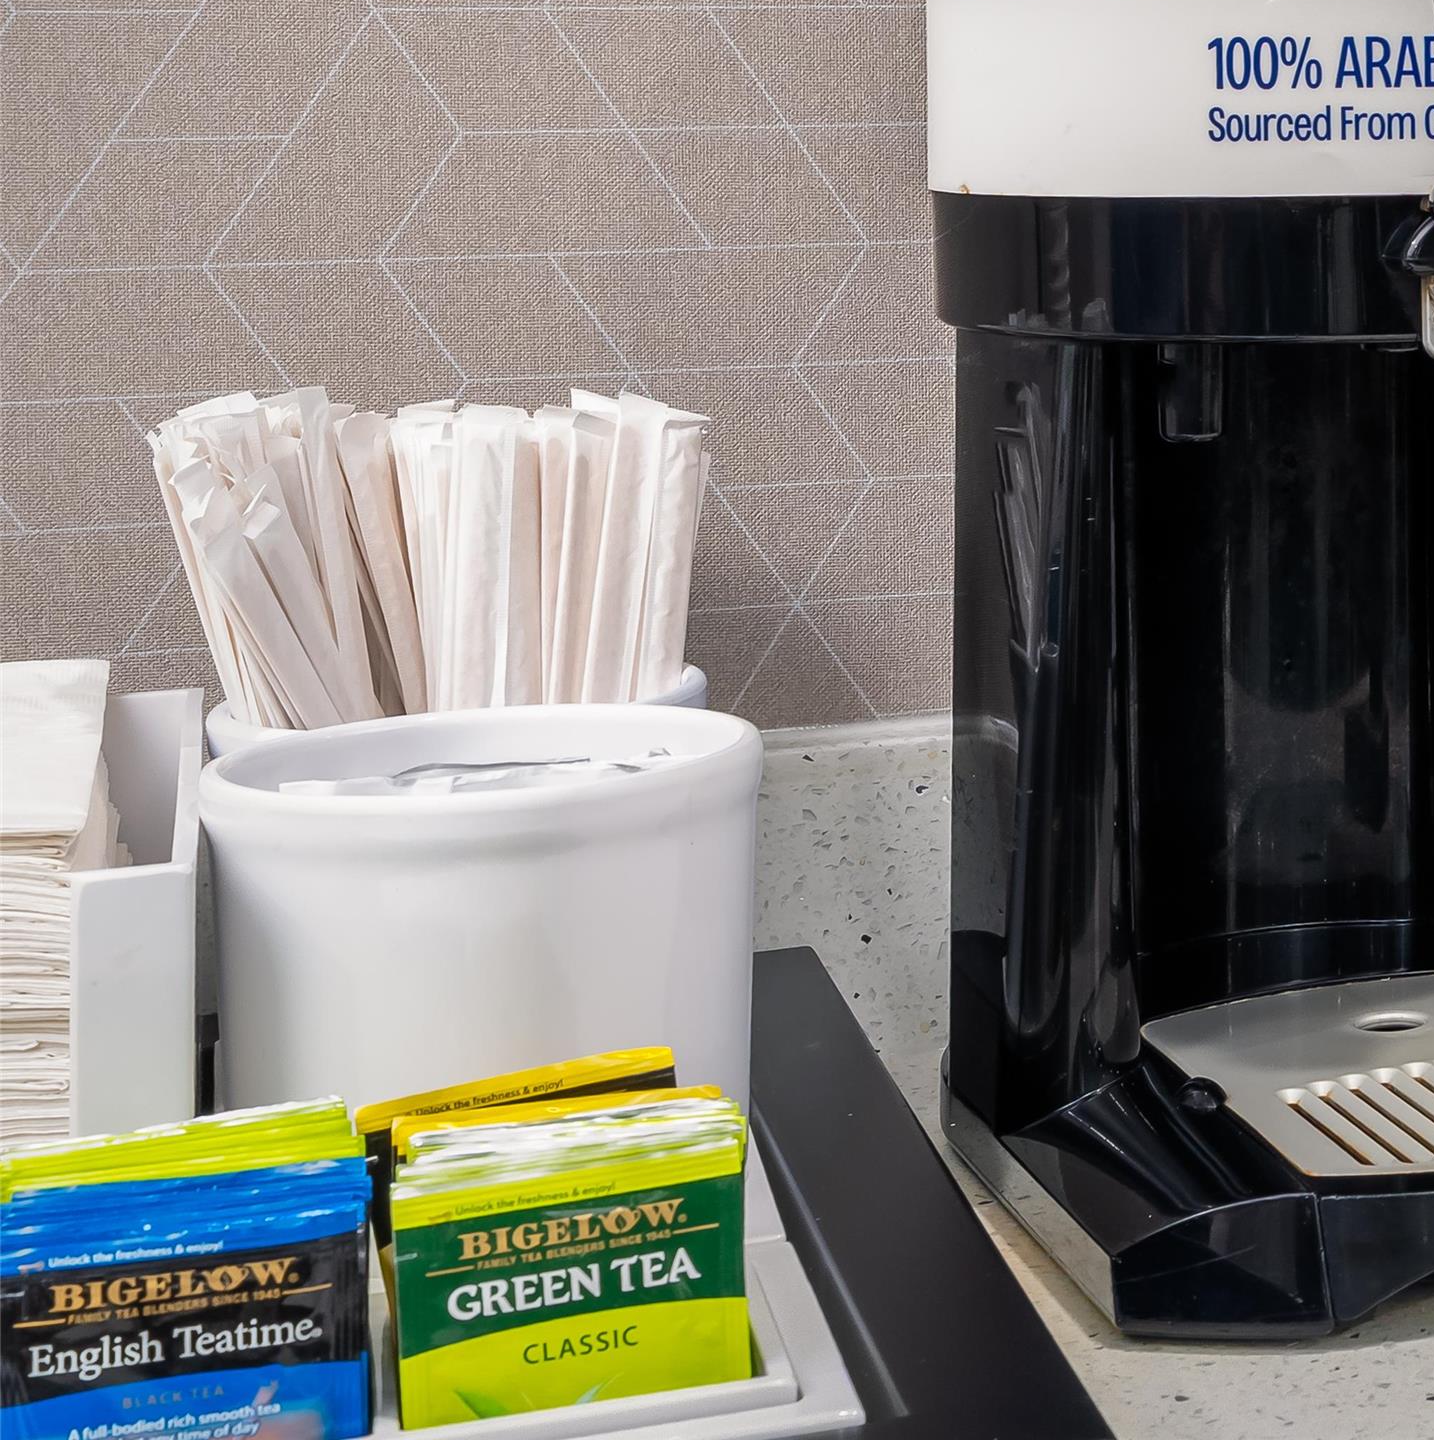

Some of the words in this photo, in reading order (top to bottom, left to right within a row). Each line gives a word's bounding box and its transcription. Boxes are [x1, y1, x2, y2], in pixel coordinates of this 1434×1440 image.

[1208, 36, 1322, 90] 100%
[1208, 105, 1331, 142] Sourced
[1340, 106, 1416, 140] From
[415, 1103, 451, 1116] Unlock
[454, 1100, 470, 1109] the
[473, 1089, 520, 1105] freshness
[522, 1086, 530, 1095] &
[533, 1079, 564, 1092] enjoy!
[455, 1200, 493, 1216] Unlock
[497, 1196, 514, 1209] the
[517, 1190, 569, 1207] freshness
[572, 1187, 580, 1197] &
[582, 1182, 616, 1197] enjoy!
[457, 1197, 686, 1260] BIGELOW
[48, 1253, 91, 1268] Unlock
[93, 1252, 114, 1263] the
[115, 1247, 173, 1260] freshness
[174, 1244, 184, 1255] &
[186, 1240, 224, 1254] enjoy!
[477, 1255, 516, 1270] FAMILY
[521, 1251, 543, 1263] TEA
[546, 1241, 606, 1259] BLENDERS
[609, 1233, 642, 1249] SINCE
[646, 1229, 672, 1242] 1945
[48, 1256, 298, 1313] BIGELOW
[447, 1263, 600, 1320] GREEN
[610, 1247, 701, 1292] TEA
[67, 1311, 111, 1325] FAMILY
[116, 1308, 139, 1320] TEA
[143, 1293, 209, 1316] BLENDERS
[212, 1291, 248, 1307] SINCE
[253, 1288, 281, 1301] 1945
[27, 1330, 165, 1381] English
[523, 1325, 639, 1364] CLASSIC
[122, 1391, 183, 1409] BLACK
[192, 1386, 224, 1399] TEA
[69, 1429, 80, 1440] A
[83, 1417, 165, 1439] full-bodied
[167, 1413, 196, 1429] rich
[199, 1406, 255, 1425] smooth
[258, 1403, 281, 1415] tea
[213, 1424, 230, 1437] of
[232, 1421, 260, 1437] day
